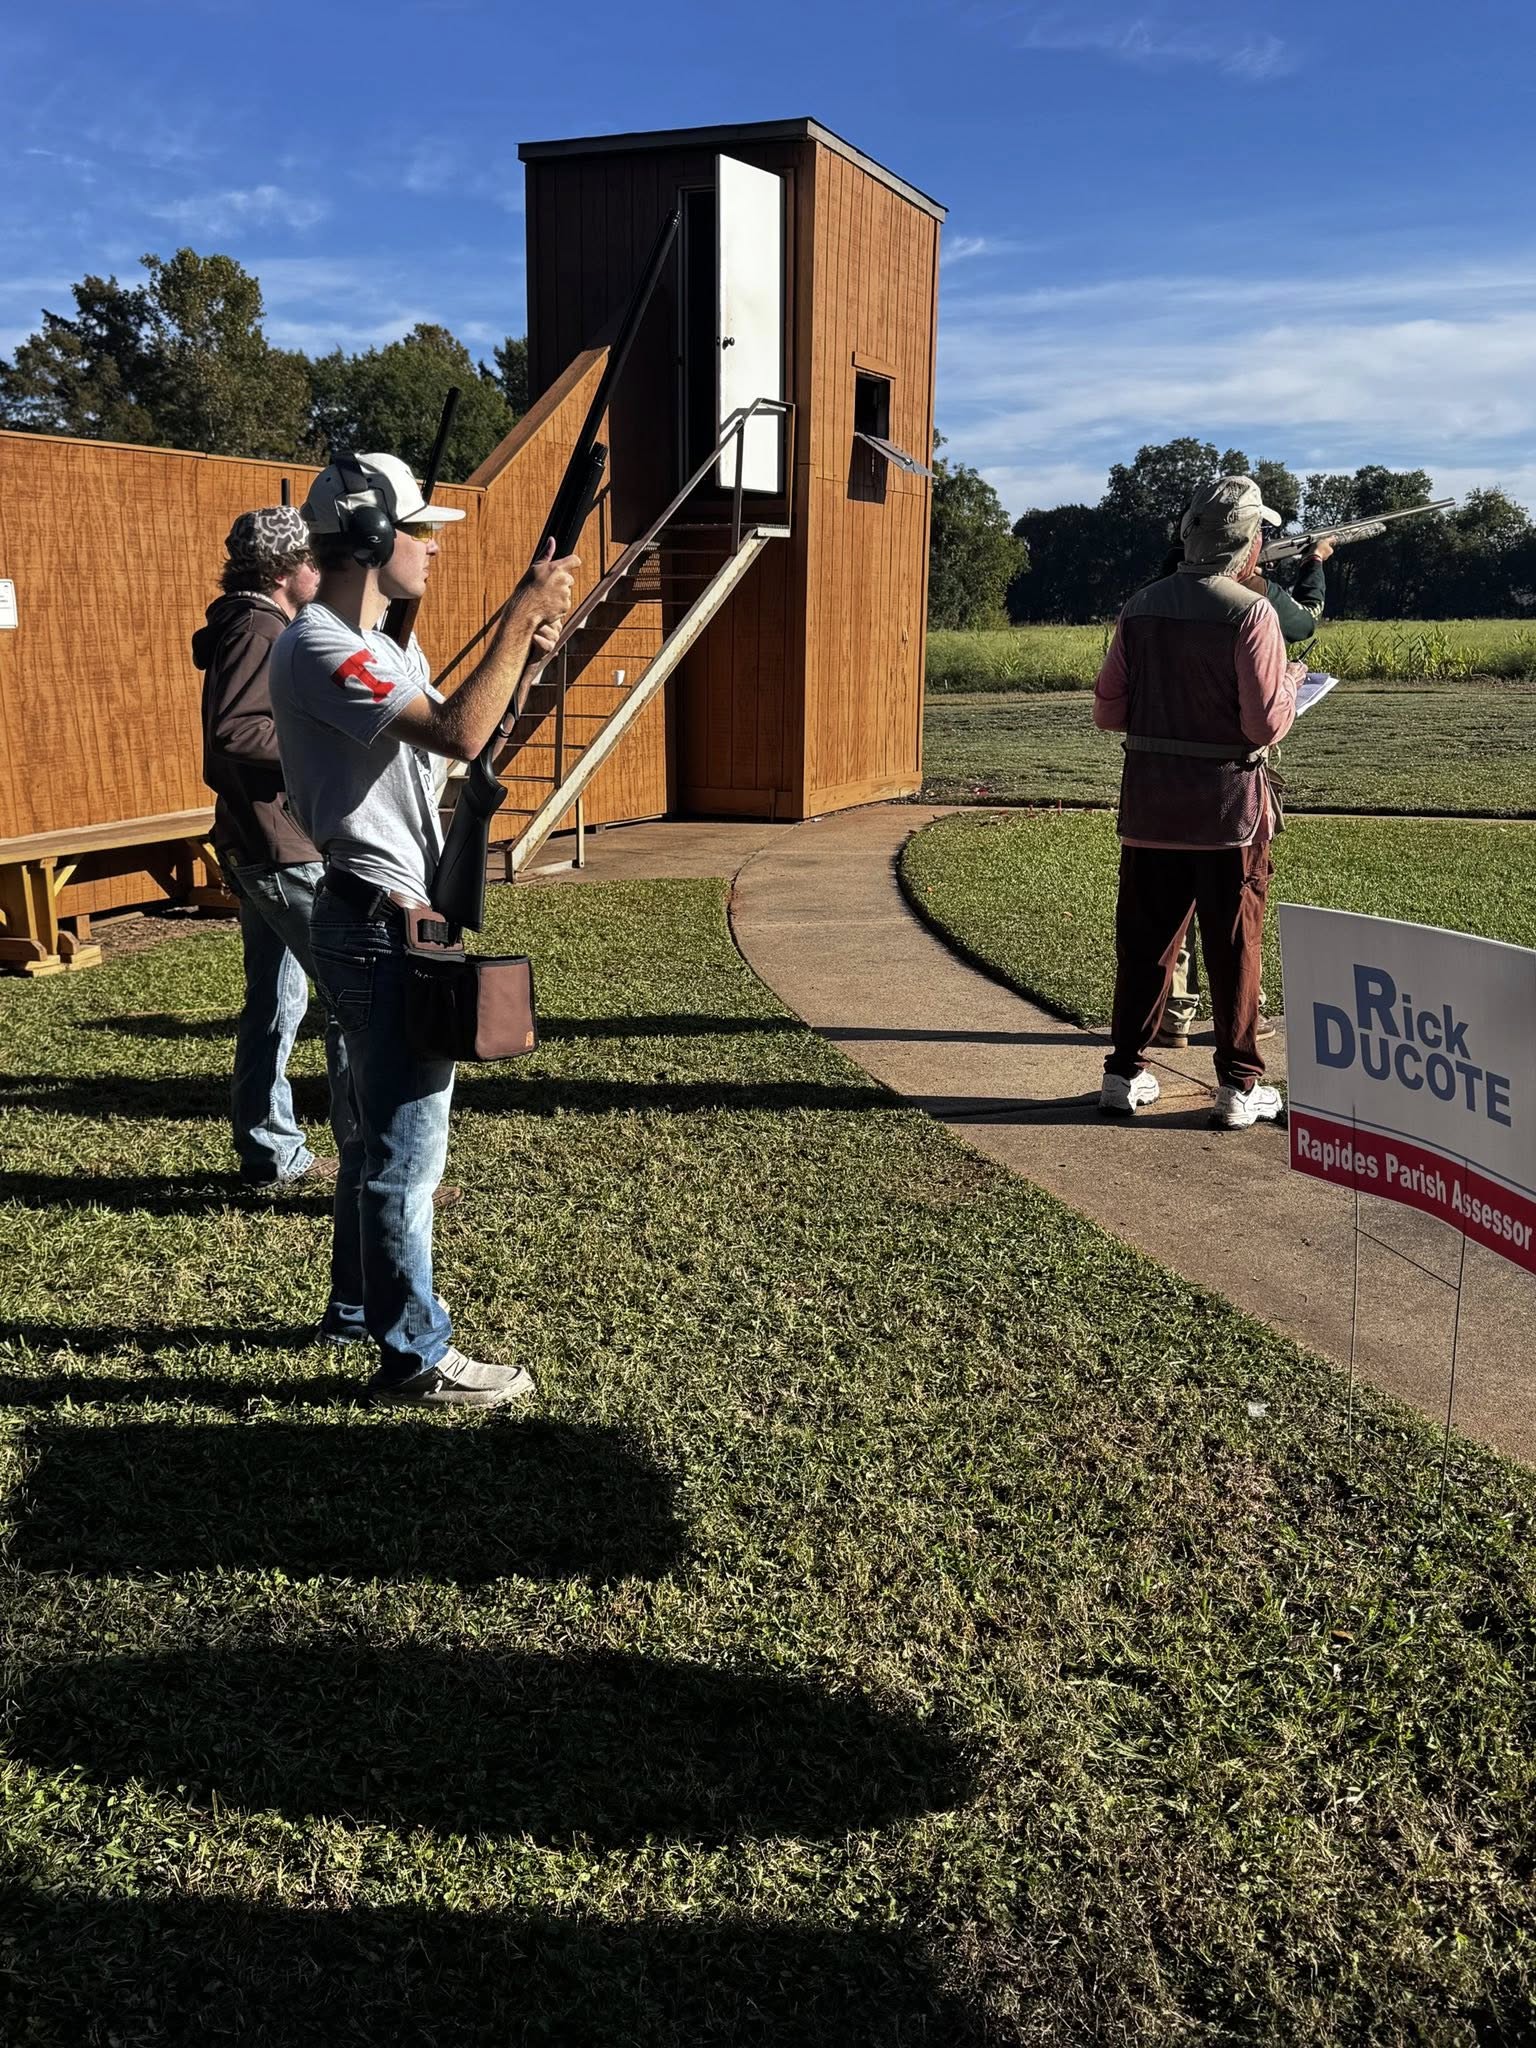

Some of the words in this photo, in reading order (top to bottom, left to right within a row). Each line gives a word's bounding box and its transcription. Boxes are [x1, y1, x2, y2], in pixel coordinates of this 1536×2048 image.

[1313, 1001, 1512, 1127] DUCOTE
[1353, 964, 1471, 1060] Rick
[1297, 1127, 1379, 1178] Rapides
[1386, 1152, 1447, 1205] Parish
[1451, 1179, 1533, 1251] Assessor
